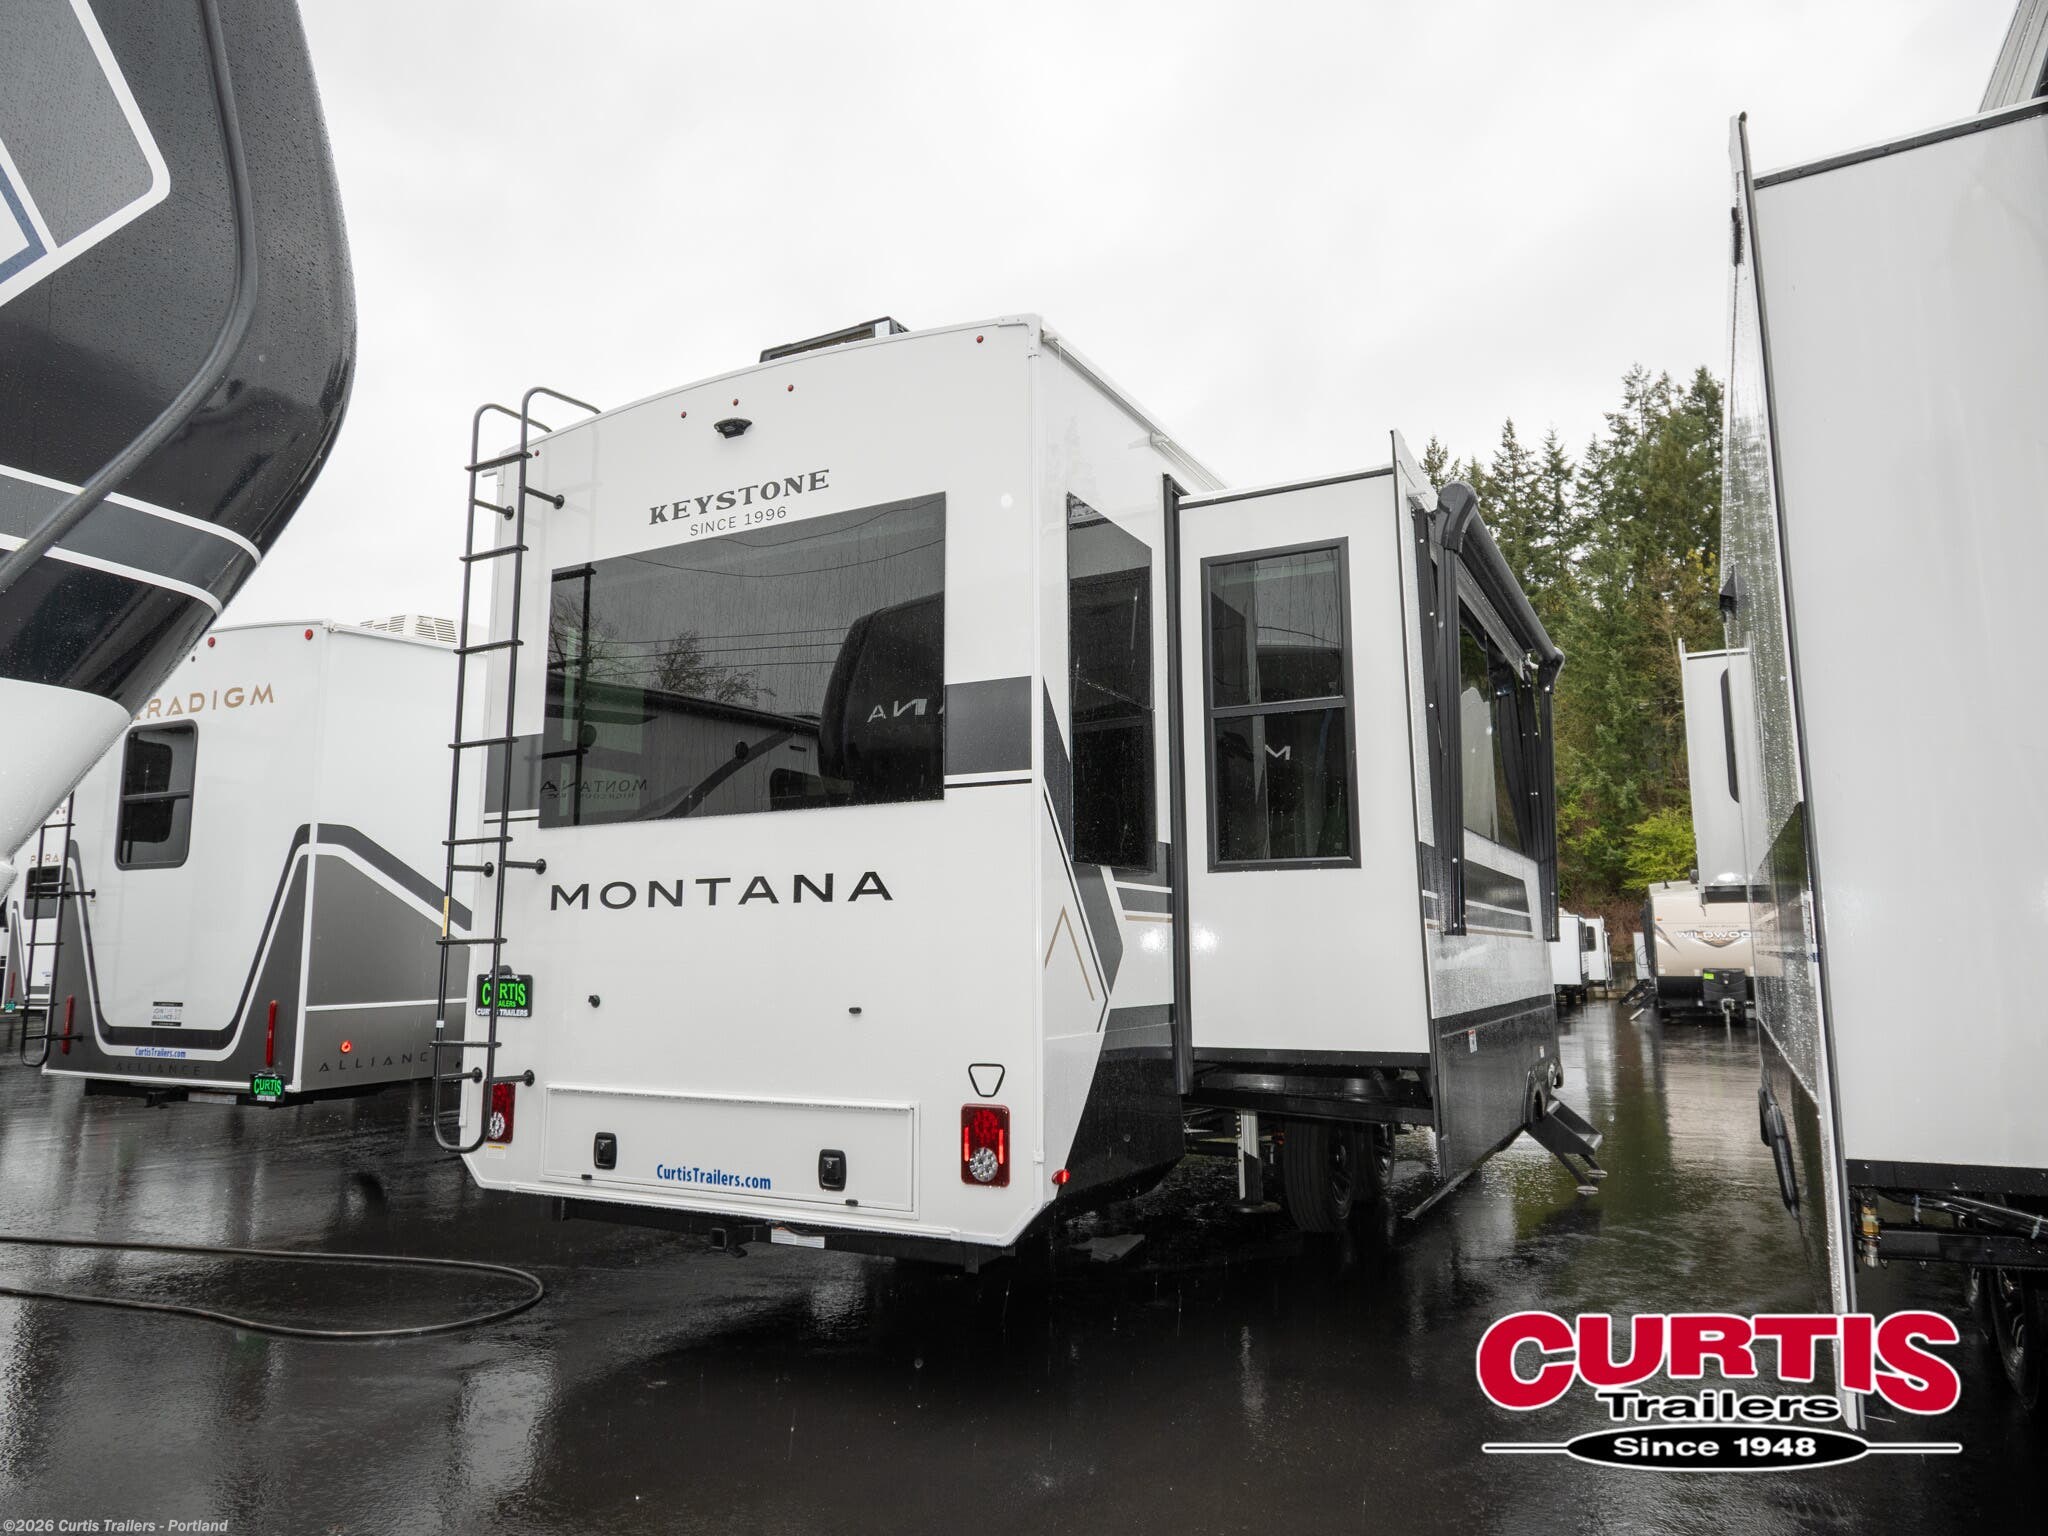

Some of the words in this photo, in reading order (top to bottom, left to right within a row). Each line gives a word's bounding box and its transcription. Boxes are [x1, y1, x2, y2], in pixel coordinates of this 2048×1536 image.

[649, 469, 829, 526] KEYSTONE
[690, 516, 737, 536] SINCE
[744, 506, 787, 526] 1996
[136, 683, 274, 720] RADIGM
[551, 871, 893, 911] MONTANA
[482, 982, 526, 1006] CRTIS
[135, 1047, 187, 1059] CurtisTrailers.com
[318, 1051, 429, 1073] ALLIANC
[253, 1078, 282, 1096] CURTIS
[656, 1164, 771, 1190] CurtisTrailers.com
